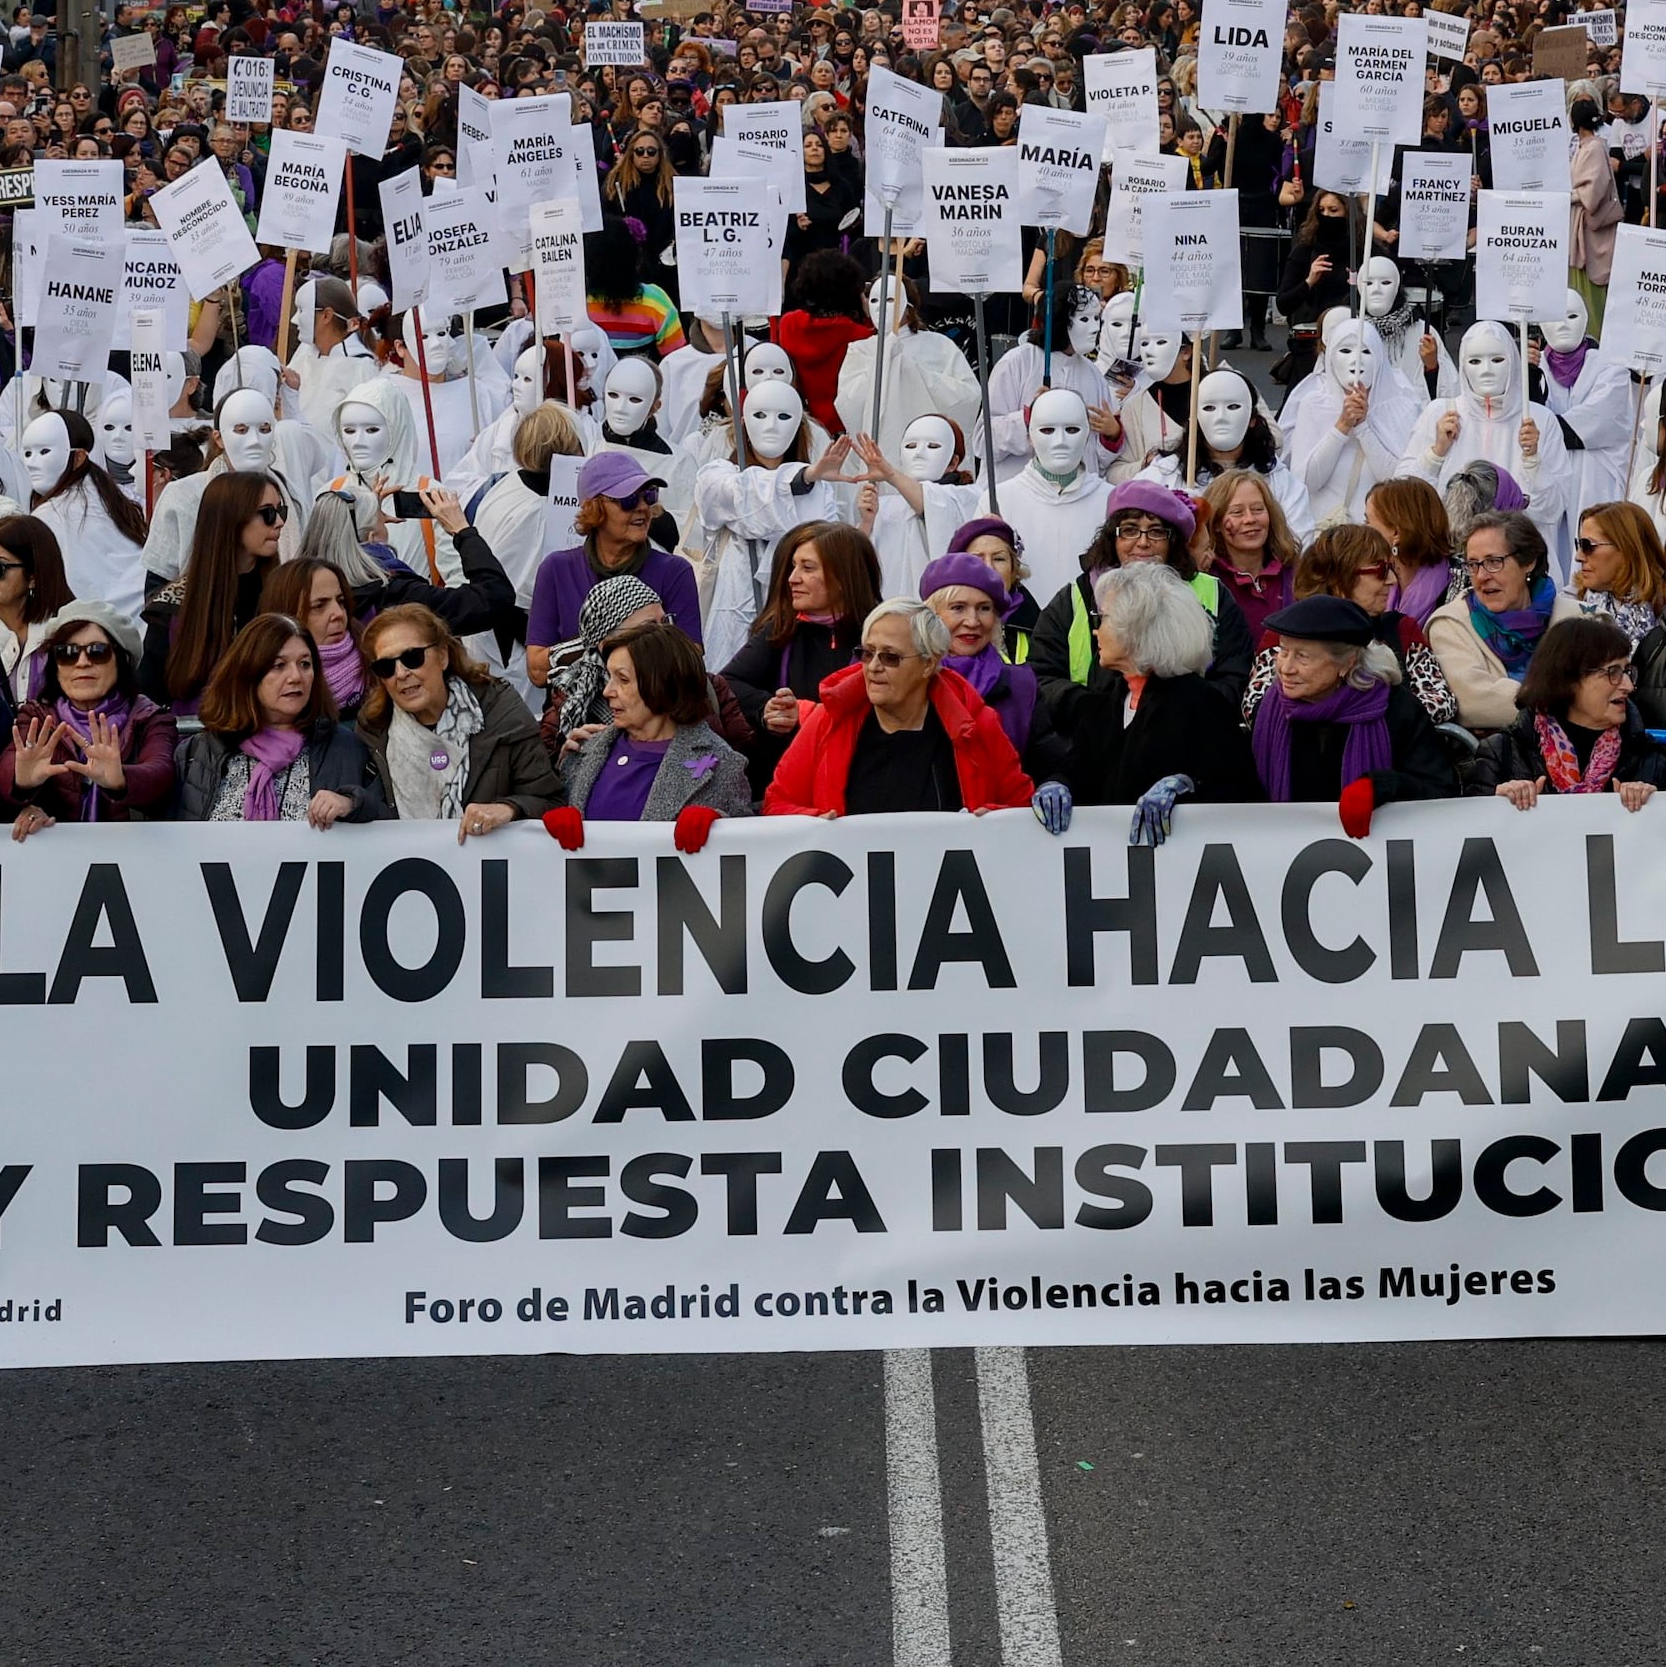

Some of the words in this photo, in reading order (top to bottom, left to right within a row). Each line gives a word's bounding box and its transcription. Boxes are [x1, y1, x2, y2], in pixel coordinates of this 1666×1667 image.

[587, 26, 597, 38] EL
[1214, 26, 1269, 49] LIDA
[587, 41, 595, 49] es
[597, 41, 605, 49] un
[606, 39, 641, 50] CRIMEN
[1348, 46, 1390, 58] MARÍA
[1392, 46, 1414, 59] DEL
[588, 52, 616, 63] CONTRA
[618, 52, 641, 62] TODOS
[1222, 52, 1233, 62] 39
[1235, 53, 1258, 63] años
[1354, 58, 1407, 71] CARMEN
[246, 61, 268, 77] 016:
[1356, 68, 1404, 82] GARCÍA
[871, 105, 930, 139] CATERINA
[1492, 116, 1562, 135] MIGUELA
[513, 134, 555, 151] MARÍA
[506, 146, 563, 166] ÁNGELES
[1020, 139, 1094, 172] MARÍA
[932, 184, 1010, 201] VANESA
[939, 201, 1002, 220] MARÍN
[680, 212, 760, 227] BEATRIZ
[703, 228, 718, 243] L.
[722, 228, 742, 243] G.
[1175, 234, 1208, 246] NINA
[47, 281, 114, 304] HANANE
[199, 850, 1018, 1002] VIOLENCIA
[1063, 834, 1541, 986] HACIA
[249, 1038, 795, 1131] UNIDAD
[77, 1150, 888, 1248] RESPUESTA
[405, 1291, 503, 1324] Foro
[516, 1287, 569, 1323] de
[583, 1283, 740, 1321] Madrid
[754, 1285, 894, 1318] contra
[907, 1279, 945, 1314] la
[955, 1273, 1161, 1312] Violencia
[1174, 1269, 1291, 1305] hacia
[1304, 1267, 1365, 1301] las
[1378, 1262, 1556, 1307] Mujeres
